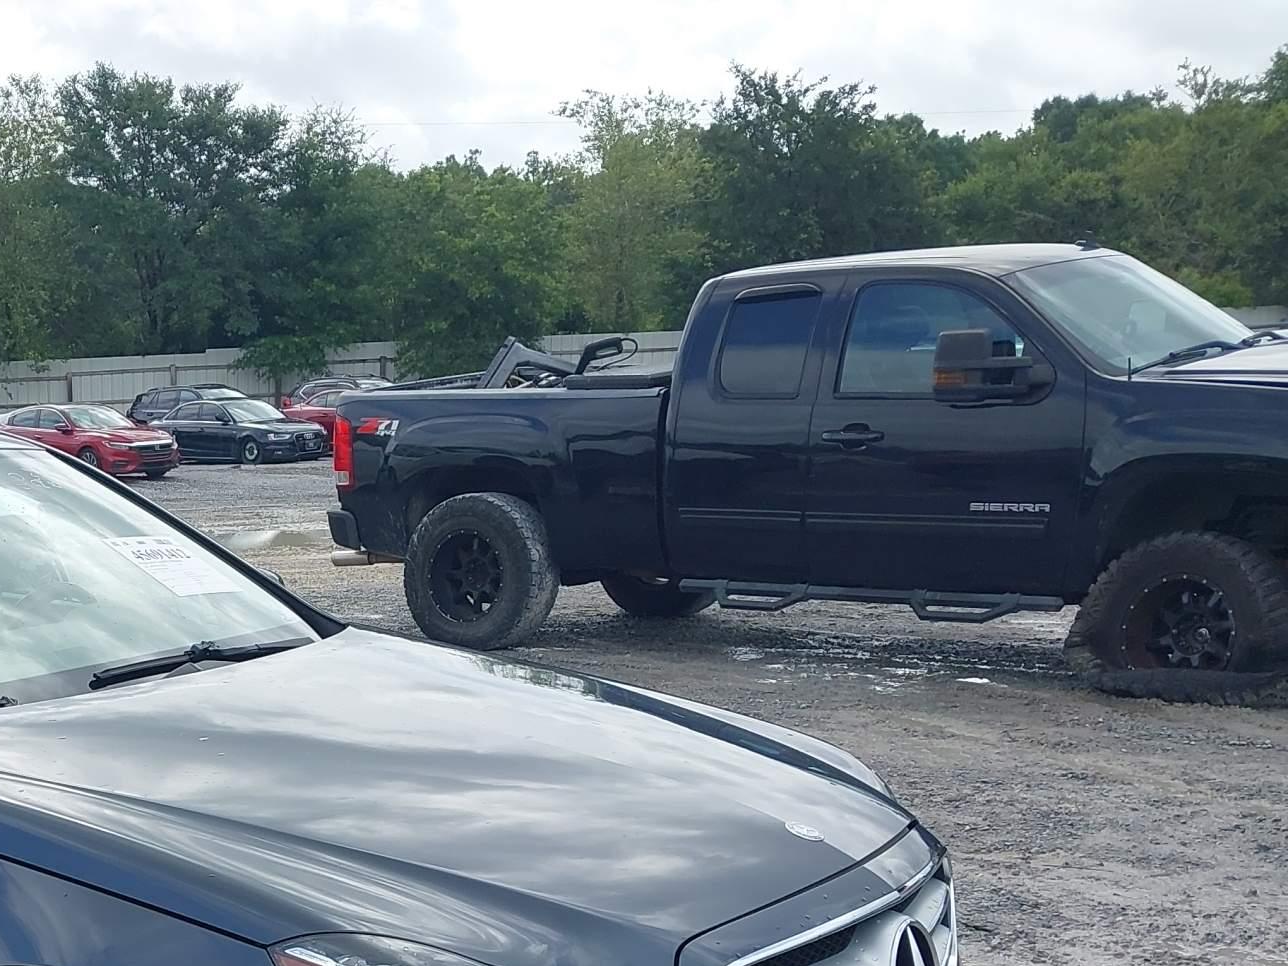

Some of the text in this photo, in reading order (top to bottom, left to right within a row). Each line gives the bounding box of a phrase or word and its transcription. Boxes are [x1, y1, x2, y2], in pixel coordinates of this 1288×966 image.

[356, 417, 400, 434] Z71
[969, 502, 1051, 513] SIERRA
[130, 547, 192, 562] 45691412
